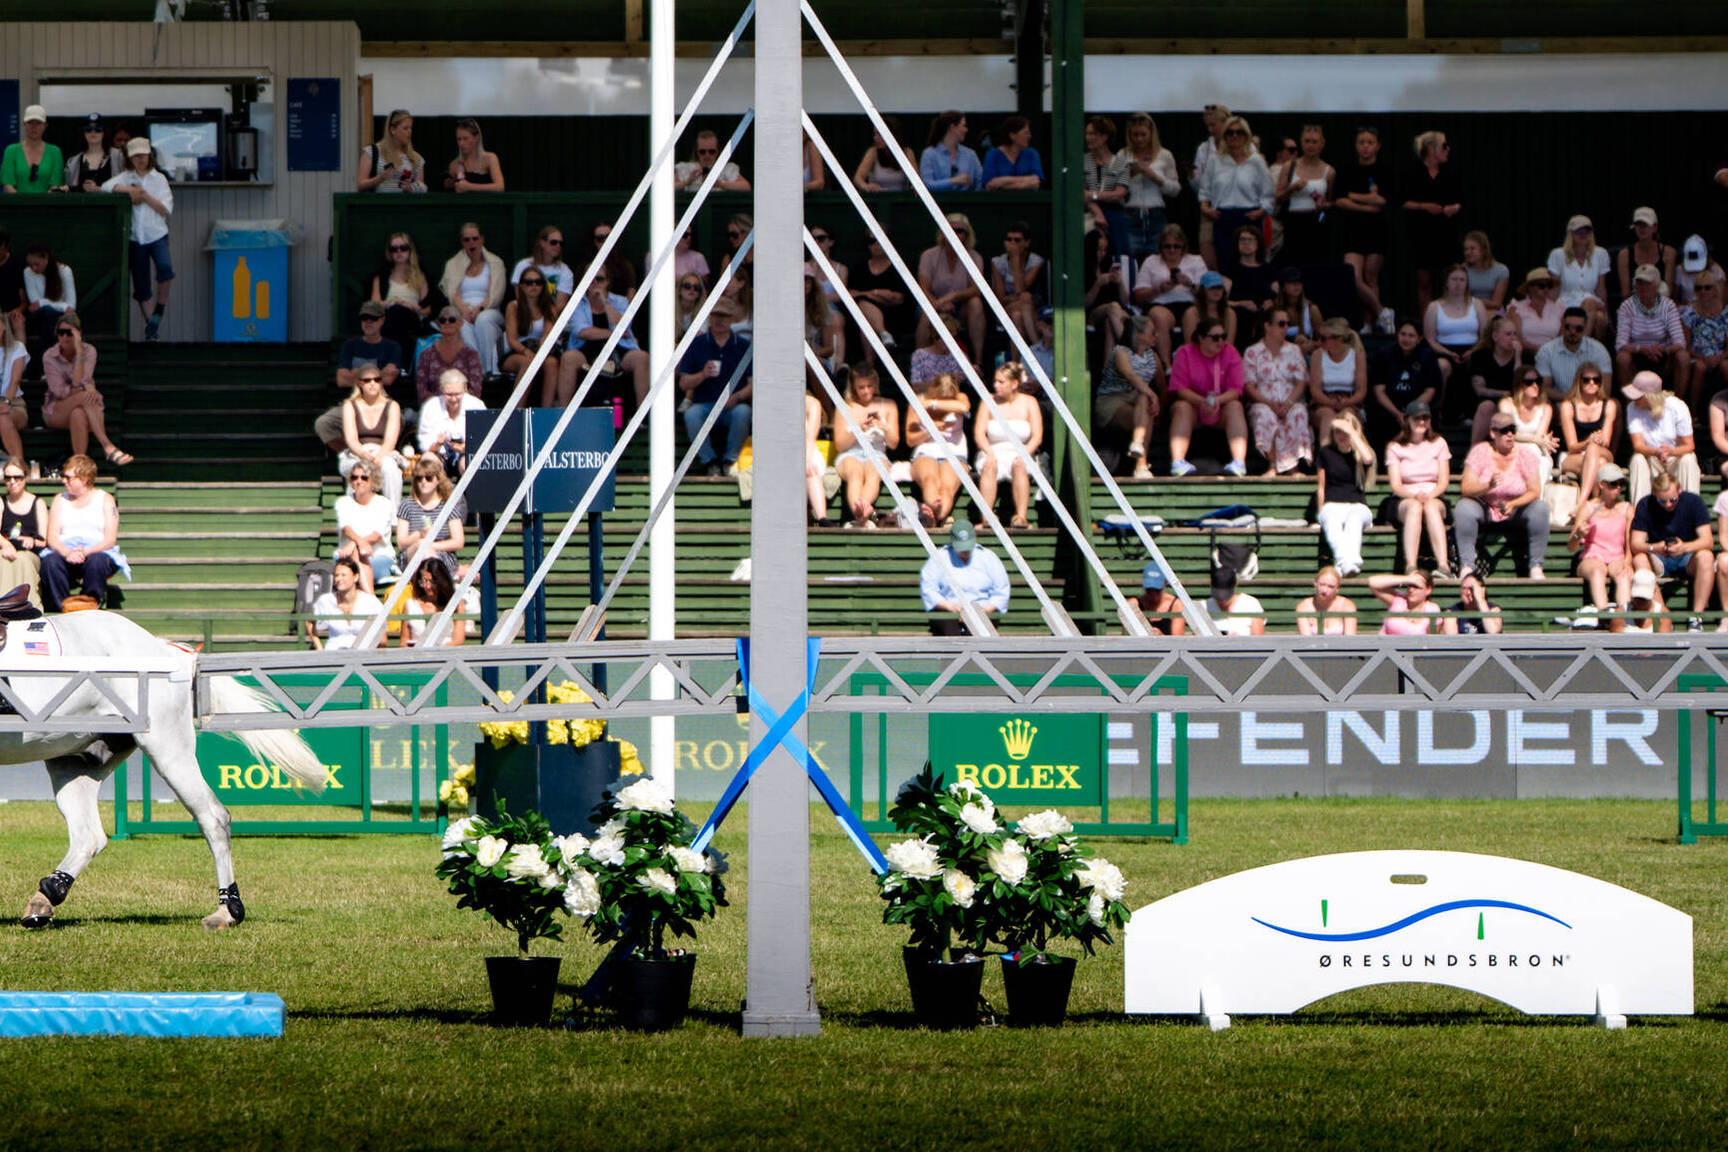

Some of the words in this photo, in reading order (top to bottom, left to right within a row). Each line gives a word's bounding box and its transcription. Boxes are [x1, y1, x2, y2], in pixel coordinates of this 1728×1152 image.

[468, 452, 522, 470] FLSTERBO
[1107, 711, 1664, 765] FENDER
[218, 764, 344, 789] ROLX
[955, 764, 1082, 789] ROLEX
[1319, 954, 1565, 969] ØRESUNDSBRON
